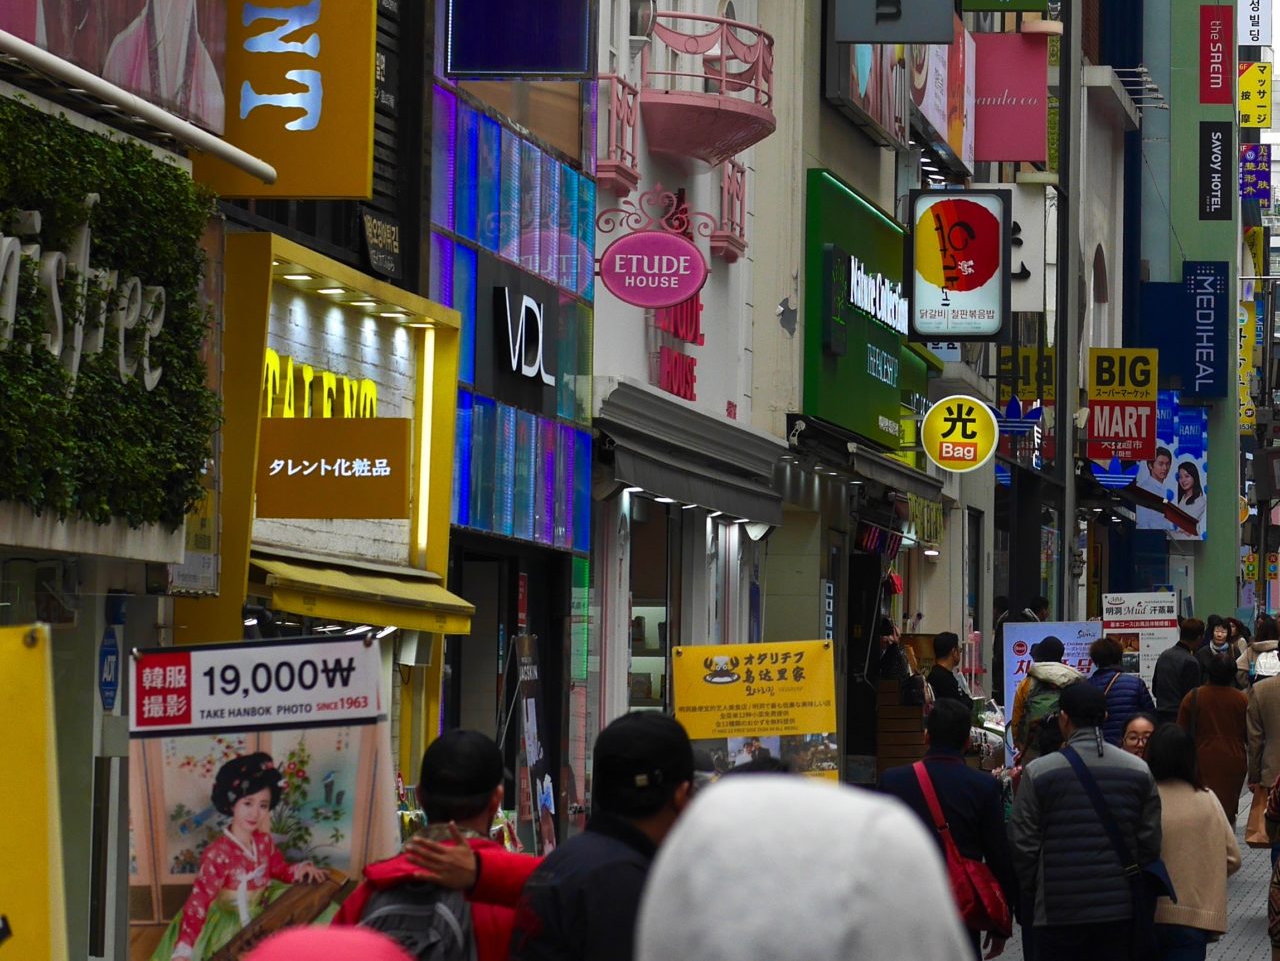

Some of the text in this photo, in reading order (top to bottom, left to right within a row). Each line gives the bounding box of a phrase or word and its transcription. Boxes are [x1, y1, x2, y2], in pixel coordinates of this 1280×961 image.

[1210, 20, 1223, 89] the SAEM
[1241, 90, 1251, 124] 按摩
[1256, 65, 1267, 124] マッサージ
[1211, 131, 1222, 212] SAVOY HOTEL
[614, 255, 692, 274] ETUDE
[625, 276, 679, 288] HOUSE
[850, 254, 877, 316] Nature
[919, 309, 995, 320] 닭갈비 철판볶음밥
[505, 286, 556, 387] VDL
[1195, 275, 1215, 392] MEDIHEAL
[660, 345, 697, 401] HOUSE
[1096, 355, 1151, 387] BIG
[1095, 389, 1151, 398] スーパーマーケット
[940, 403, 978, 440] 光
[1093, 406, 1151, 439] MART
[269, 458, 392, 477] タレント化粧品
[942, 443, 975, 460] Bag
[102, 655, 118, 683] ADT
[143, 665, 187, 690] 韓服
[203, 657, 356, 699] 19,000₩
[142, 694, 187, 719] 撮影
[200, 696, 369, 720] TAKE HANBOK PHOTO SINCE 1963
